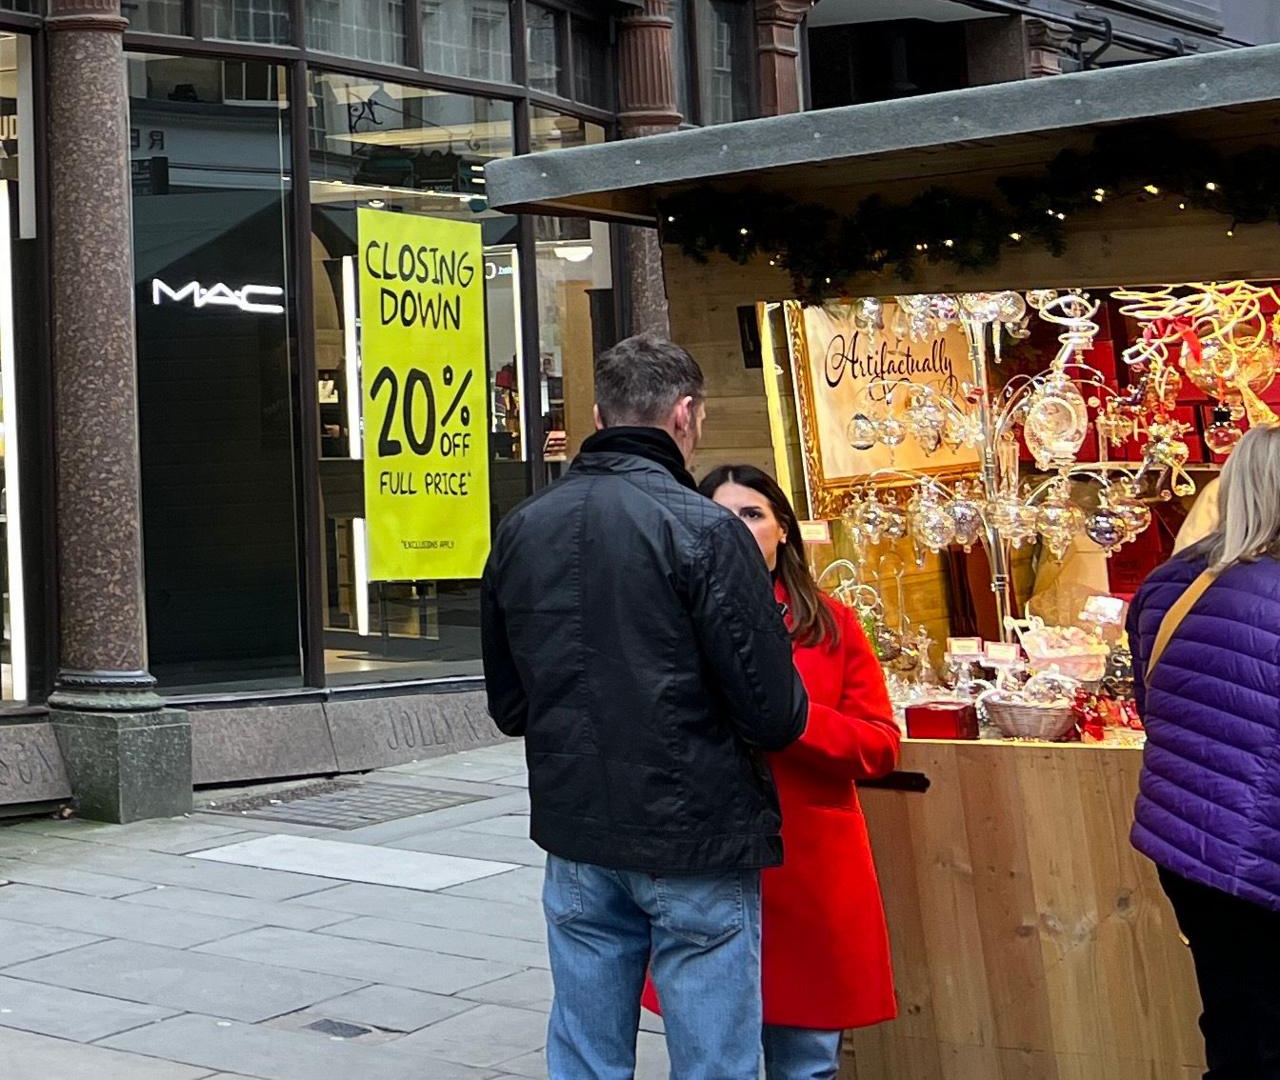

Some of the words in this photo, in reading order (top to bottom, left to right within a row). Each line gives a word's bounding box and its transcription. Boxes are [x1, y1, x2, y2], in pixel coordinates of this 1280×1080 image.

[365, 240, 475, 289] CLOSING
[380, 289, 461, 330] DOWN
[825, 331, 958, 404] Artifactually
[369, 364, 474, 458] 20%
[439, 432, 472, 458] OFF
[379, 471, 417, 496] FULL
